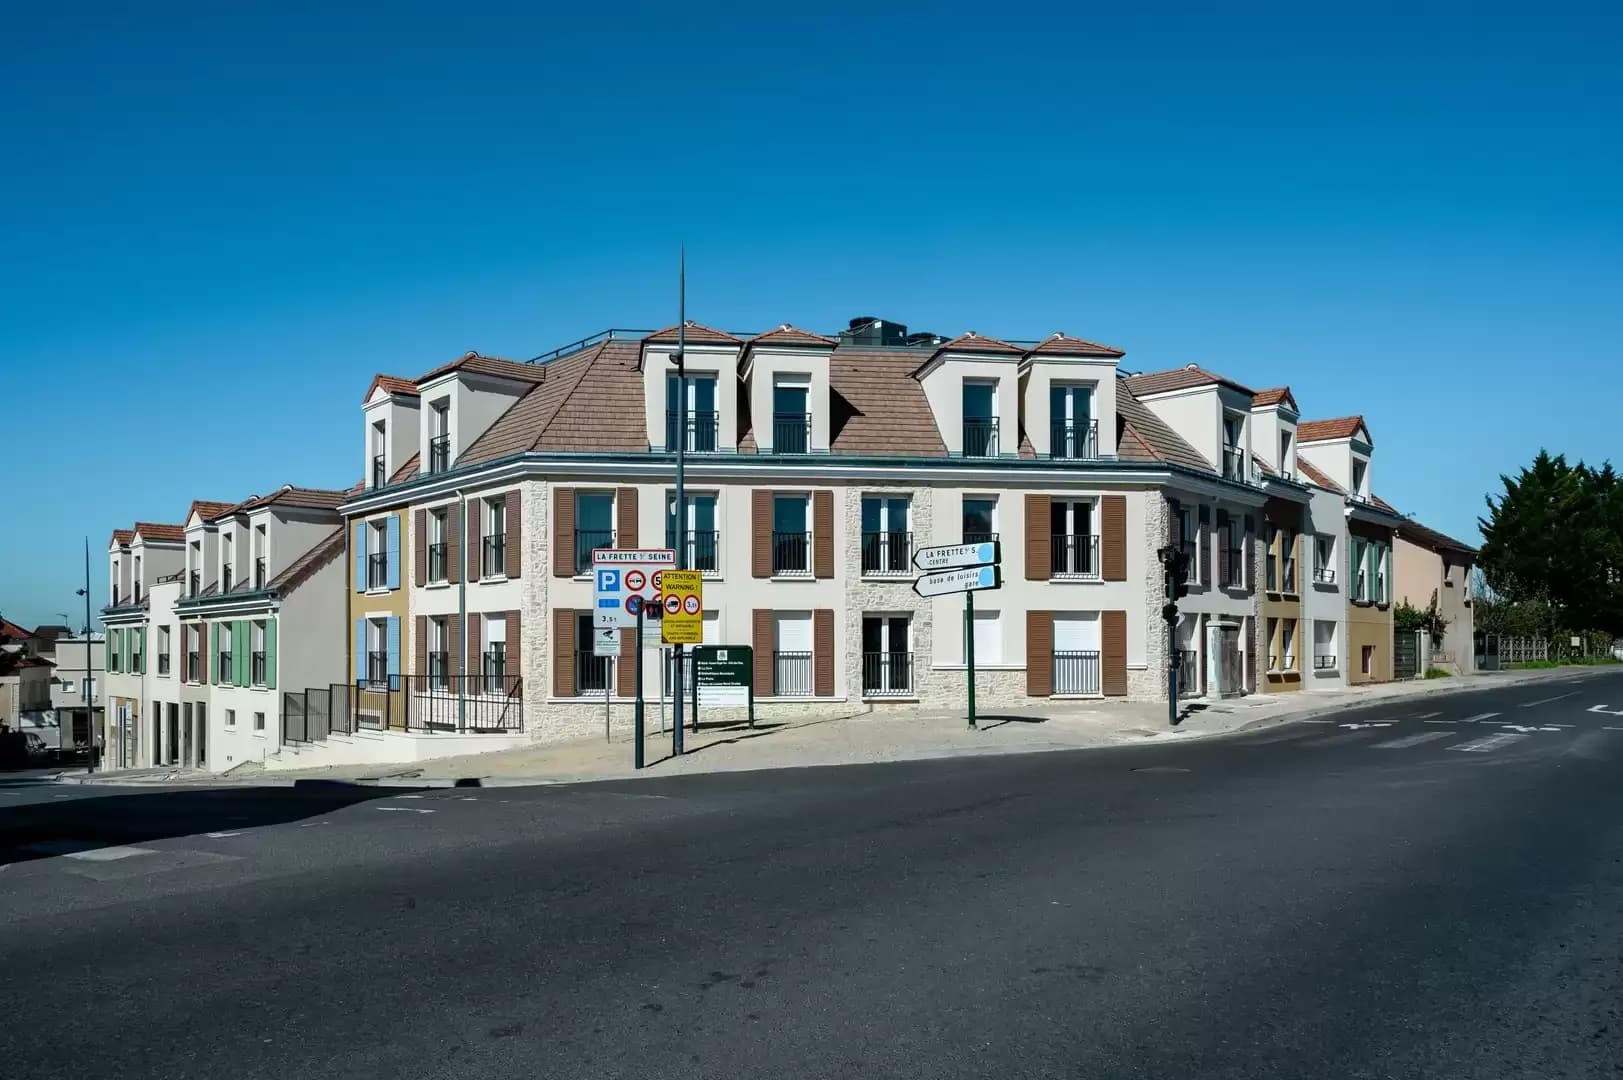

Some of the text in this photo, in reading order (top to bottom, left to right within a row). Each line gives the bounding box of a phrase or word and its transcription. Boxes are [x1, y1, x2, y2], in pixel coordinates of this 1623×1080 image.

[937, 547, 964, 557] FRETTE
[601, 572, 616, 591] P
[929, 577, 944, 585] base
[957, 571, 978, 581] loisirs
[964, 581, 979, 589] gare
